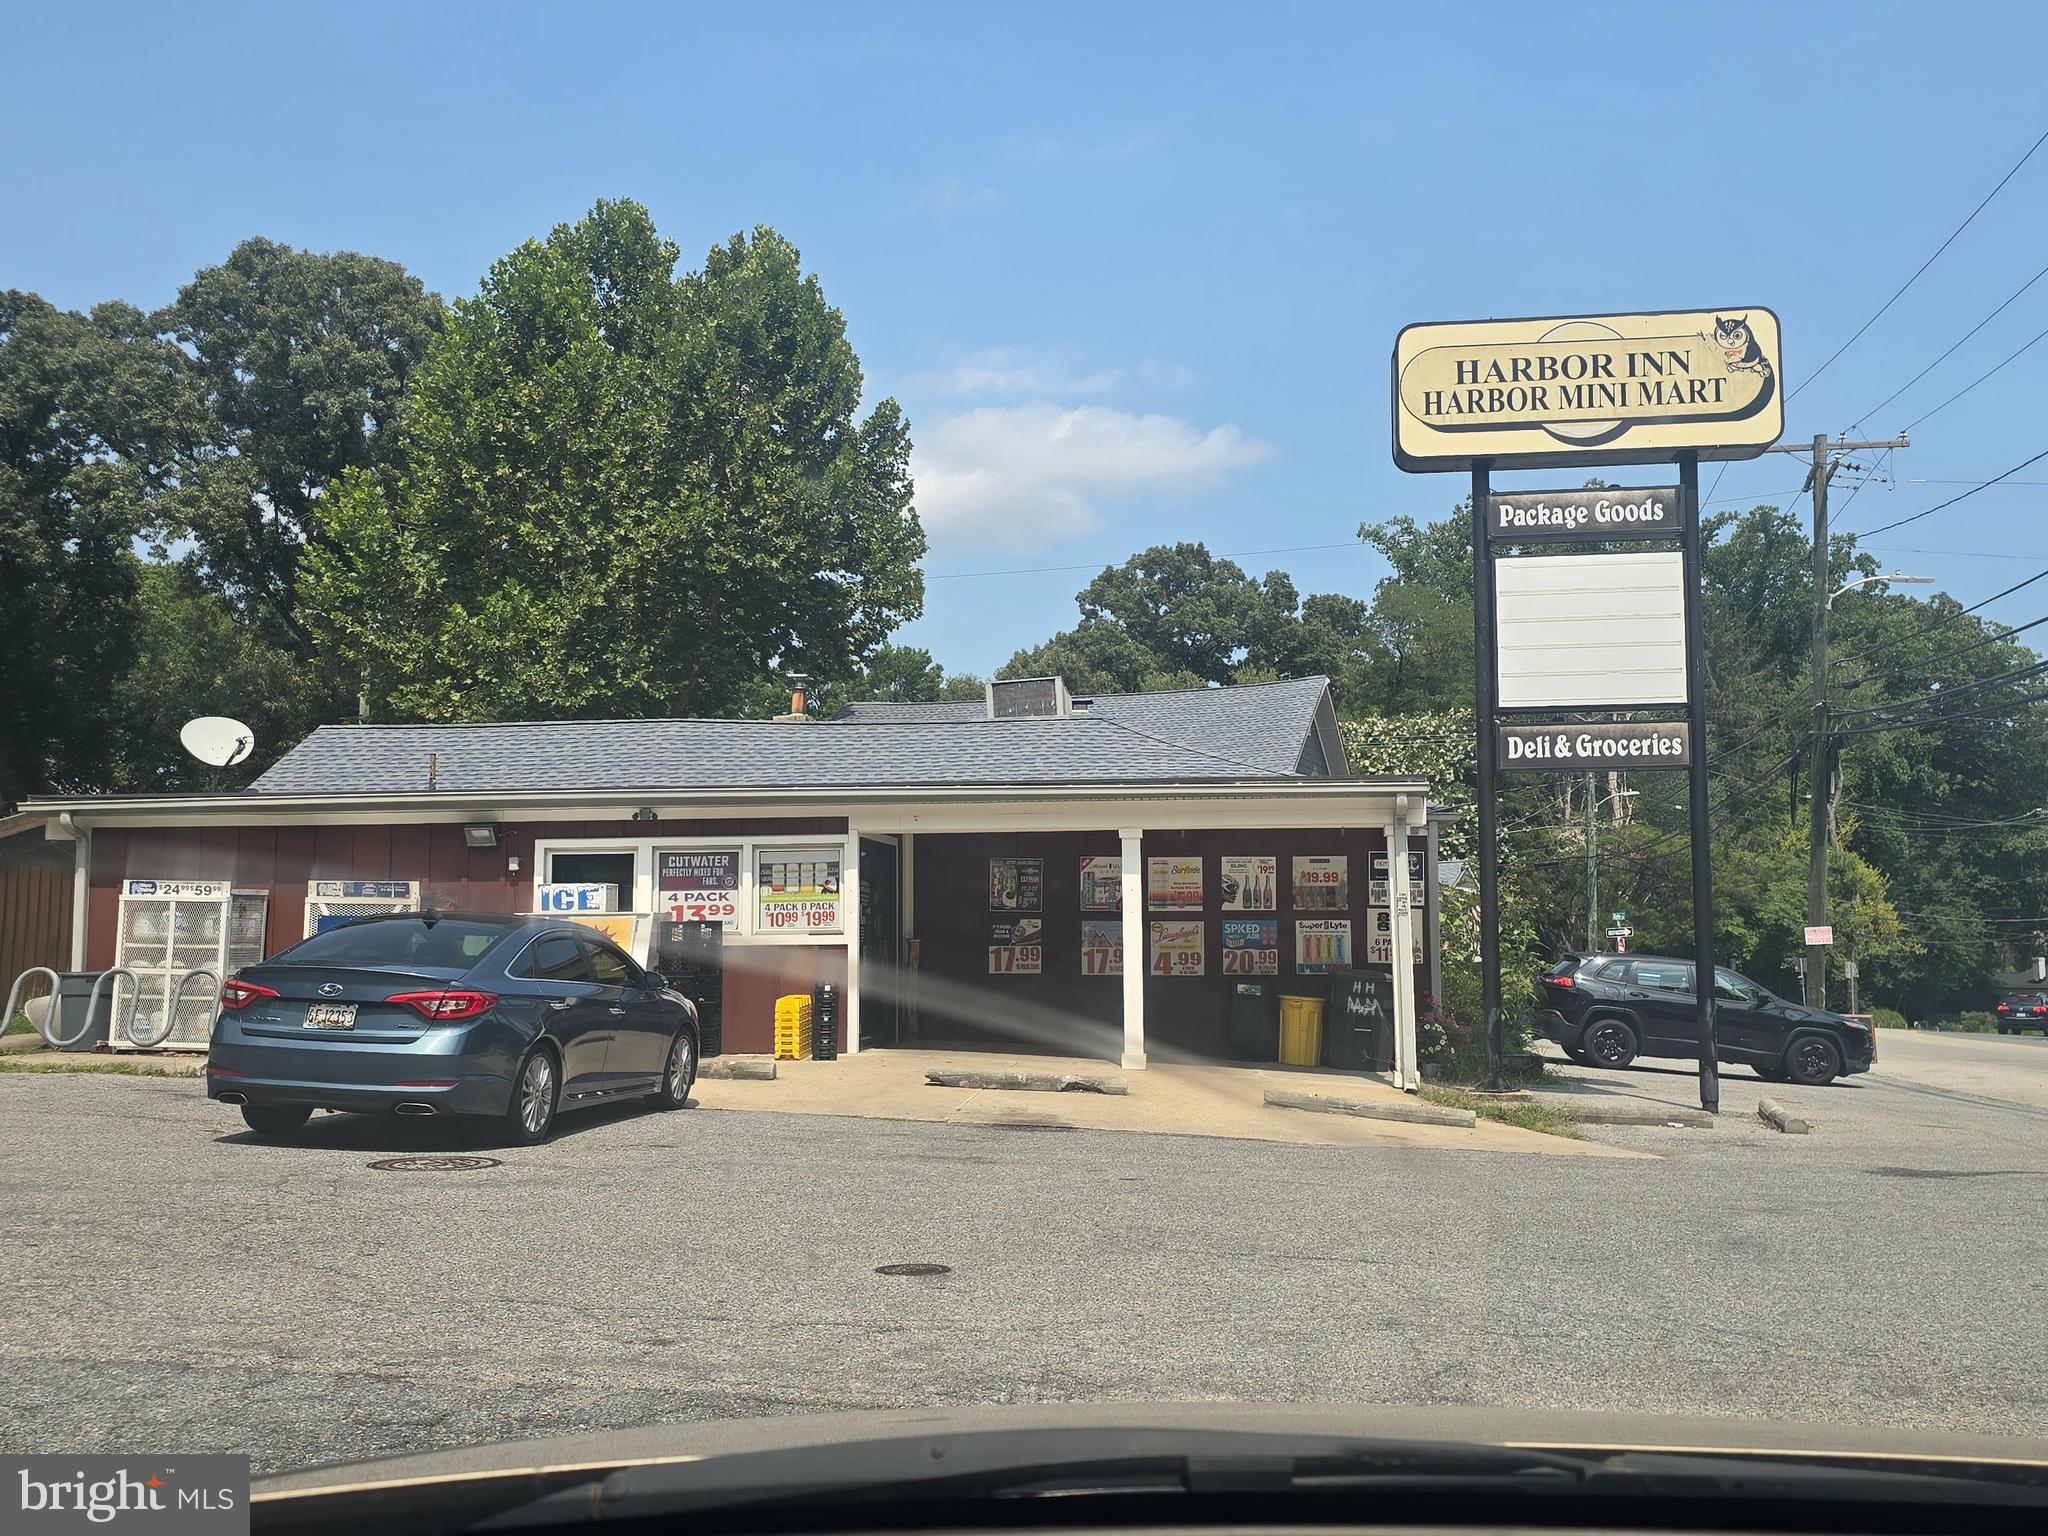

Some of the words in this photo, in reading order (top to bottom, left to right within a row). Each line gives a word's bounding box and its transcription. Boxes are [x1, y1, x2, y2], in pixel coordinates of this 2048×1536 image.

[1455, 353, 1614, 386] HARBOR
[1627, 349, 1691, 378] INN
[1423, 386, 1550, 417] HARBOR
[1558, 382, 1628, 410] MINI
[1636, 377, 1727, 407] MART
[1498, 502, 1589, 529] Package
[1594, 497, 1664, 523] Goods
[1507, 734, 1551, 759] Deli
[1554, 734, 1573, 759] &
[1575, 732, 1683, 758] Groceries
[662, 868, 693, 877] PERFECTLY
[693, 867, 711, 876] MIXED
[712, 867, 724, 876] FOR
[668, 855, 729, 867] CUTWATER
[1300, 870, 1339, 884] $19.99
[541, 887, 601, 911] ICE
[668, 893, 679, 902] 4
[684, 892, 730, 902] PACK
[765, 903, 771, 911] 4
[773, 903, 799, 911] PACK
[810, 902, 835, 911] PACK
[1375, 938, 1381, 946] 6
[990, 946, 1041, 972] 17.99
[1082, 948, 1123, 974] 17.9
[1153, 951, 1202, 975] 4.99
[1224, 950, 1277, 974] 20.99
